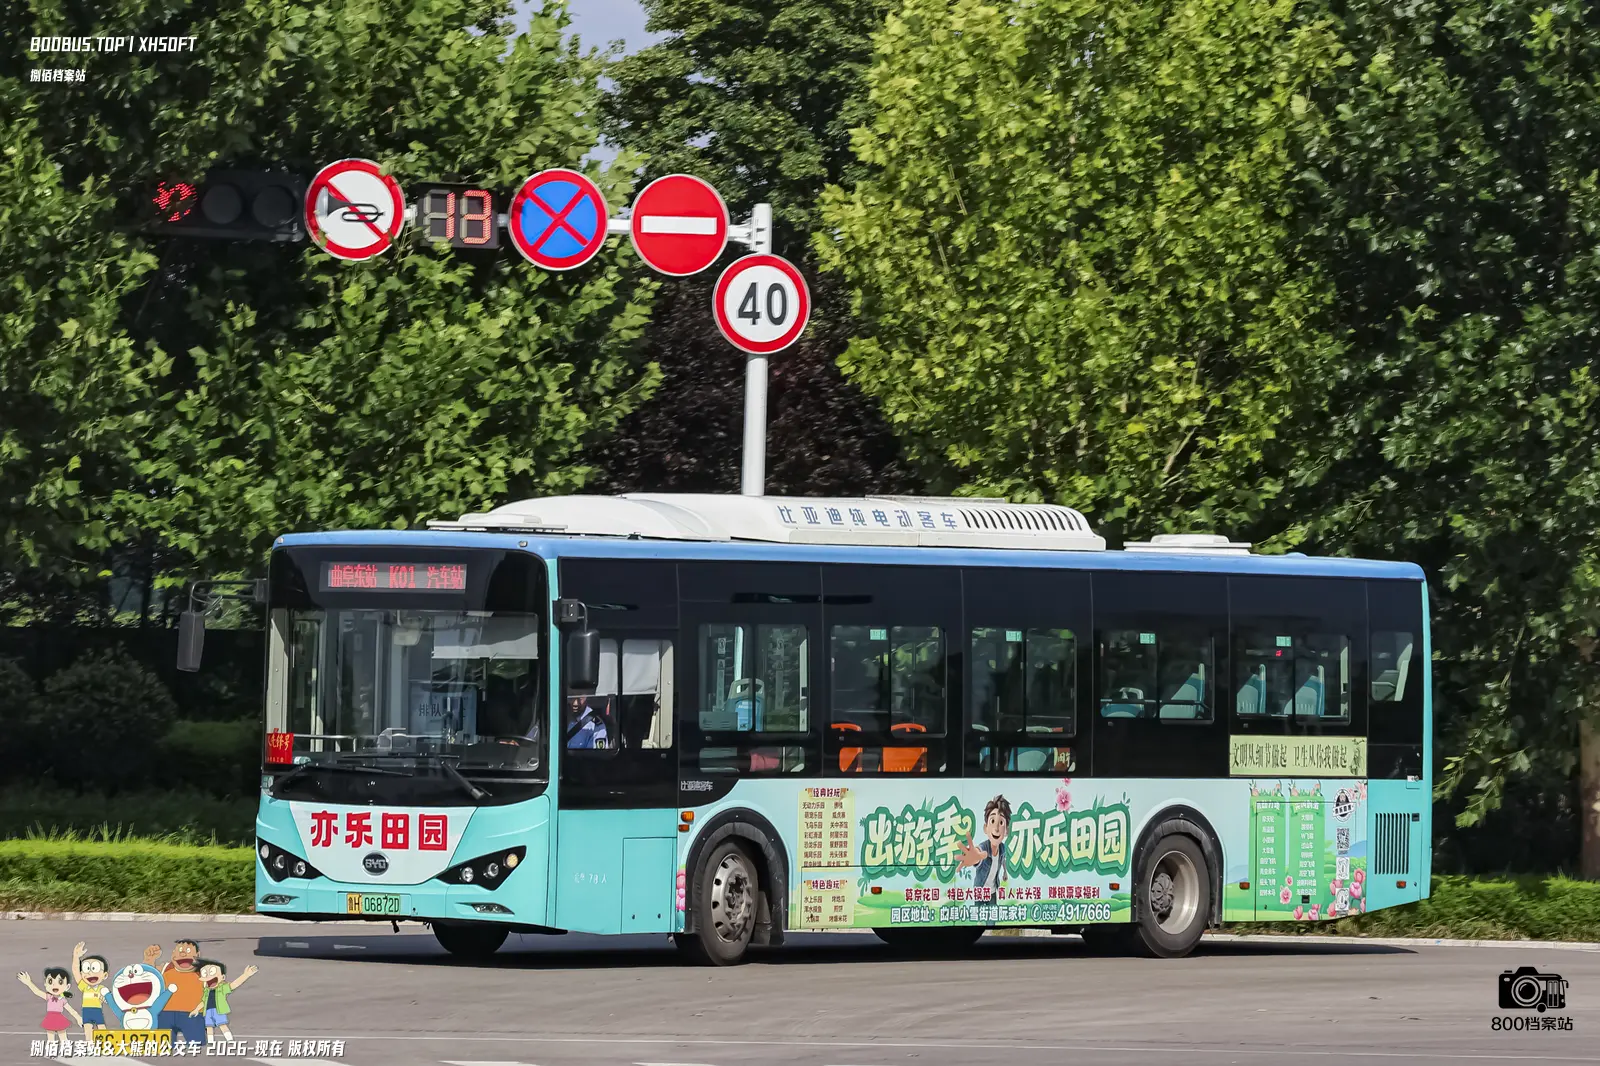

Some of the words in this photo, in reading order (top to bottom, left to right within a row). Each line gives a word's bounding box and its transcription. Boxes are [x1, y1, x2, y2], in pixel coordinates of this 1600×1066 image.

[738, 282, 788, 326] 40
[777, 505, 958, 529] 比亚迪纯电动客车
[331, 564, 377, 588] 曲阜东站
[389, 565, 416, 589] K01
[427, 565, 464, 590] 汽车站
[1231, 743, 1287, 768] 文明从细节做起
[1293, 744, 1348, 769] 卫生从你我做起
[813, 787, 840, 798] 经典好玩
[310, 810, 448, 851] 亦乐田园
[865, 804, 972, 870] 出游季
[1008, 808, 1127, 868] 亦乐田园
[364, 857, 387, 869] BYD
[812, 879, 840, 890] 特色趣玩
[905, 888, 940, 901] 莫奈花园
[947, 887, 991, 901] 特色大锅菜
[998, 887, 1041, 901] 真人光头强
[1049, 886, 1100, 900] 赚银票享福利
[1042, 911, 1057, 921] 0537
[1057, 903, 1111, 921] 4917666
